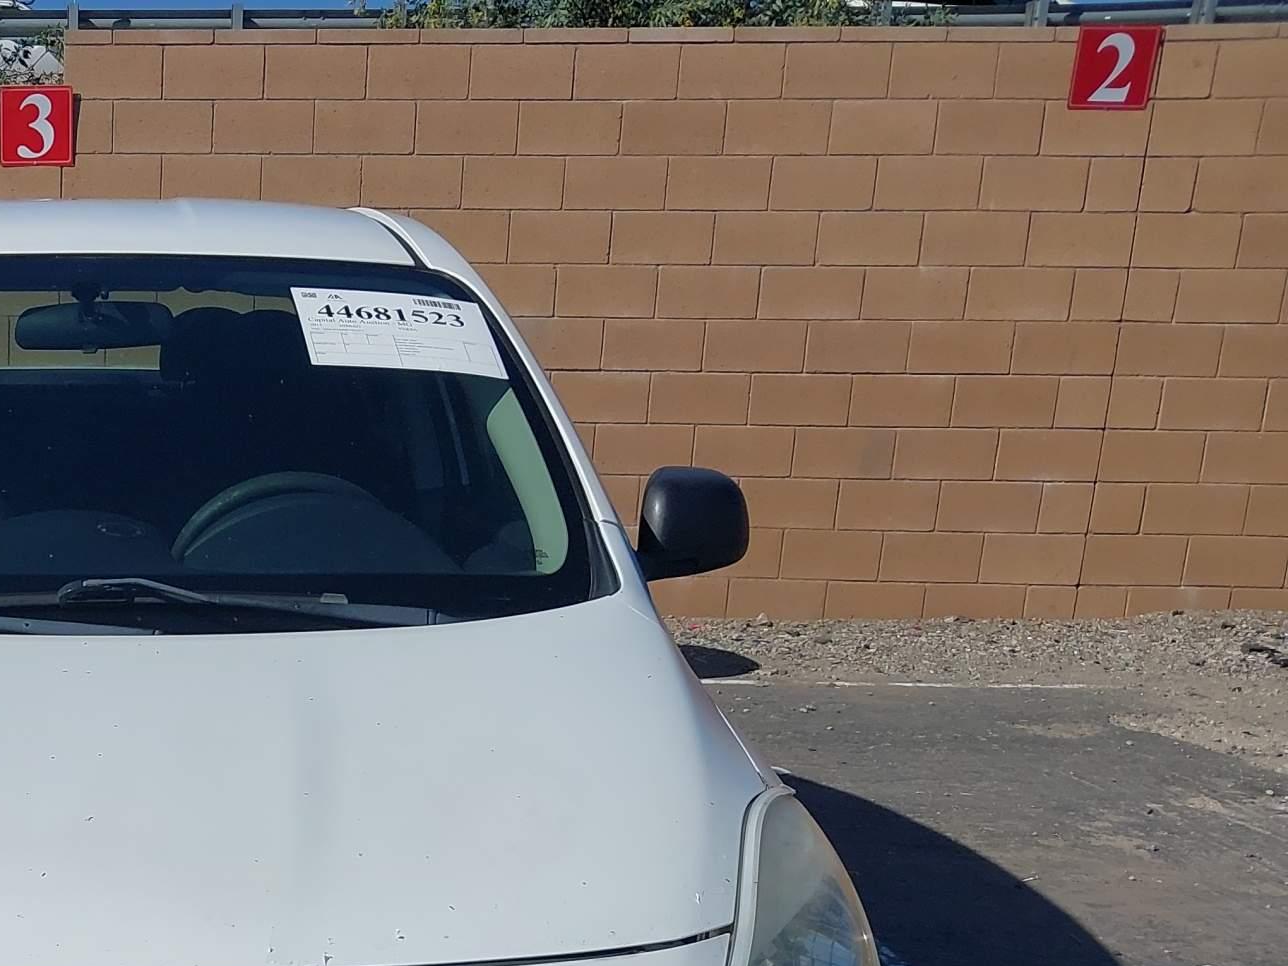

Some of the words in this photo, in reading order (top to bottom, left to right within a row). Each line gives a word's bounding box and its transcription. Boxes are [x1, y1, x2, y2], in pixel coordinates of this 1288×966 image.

[1087, 32, 1136, 103] 2
[17, 93, 55, 159] 3
[318, 304, 465, 327] 44681523
